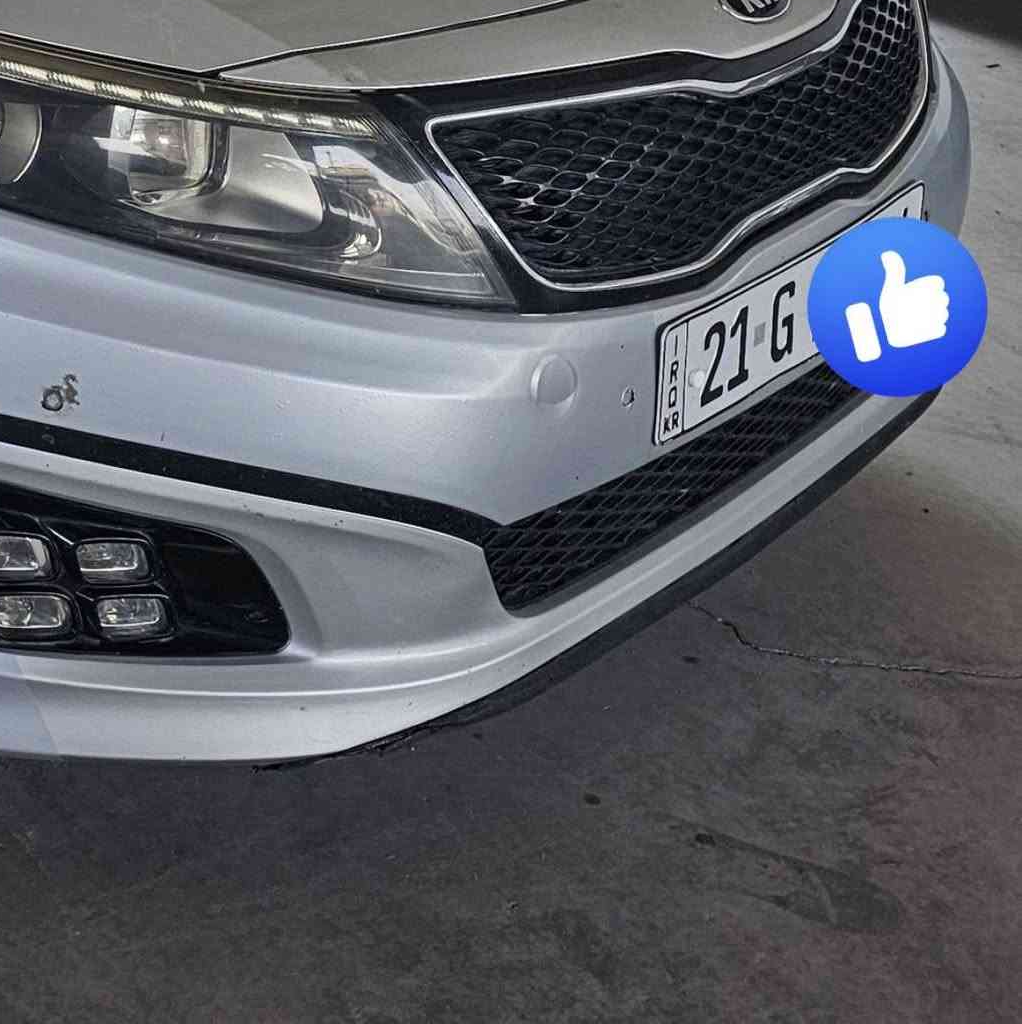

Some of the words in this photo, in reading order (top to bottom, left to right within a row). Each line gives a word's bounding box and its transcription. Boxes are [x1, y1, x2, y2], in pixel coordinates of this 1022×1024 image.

[667, 333, 680, 409] IRQ
[699, 305, 750, 407] 21
[769, 280, 796, 363] G
[662, 412, 680, 434] KR
